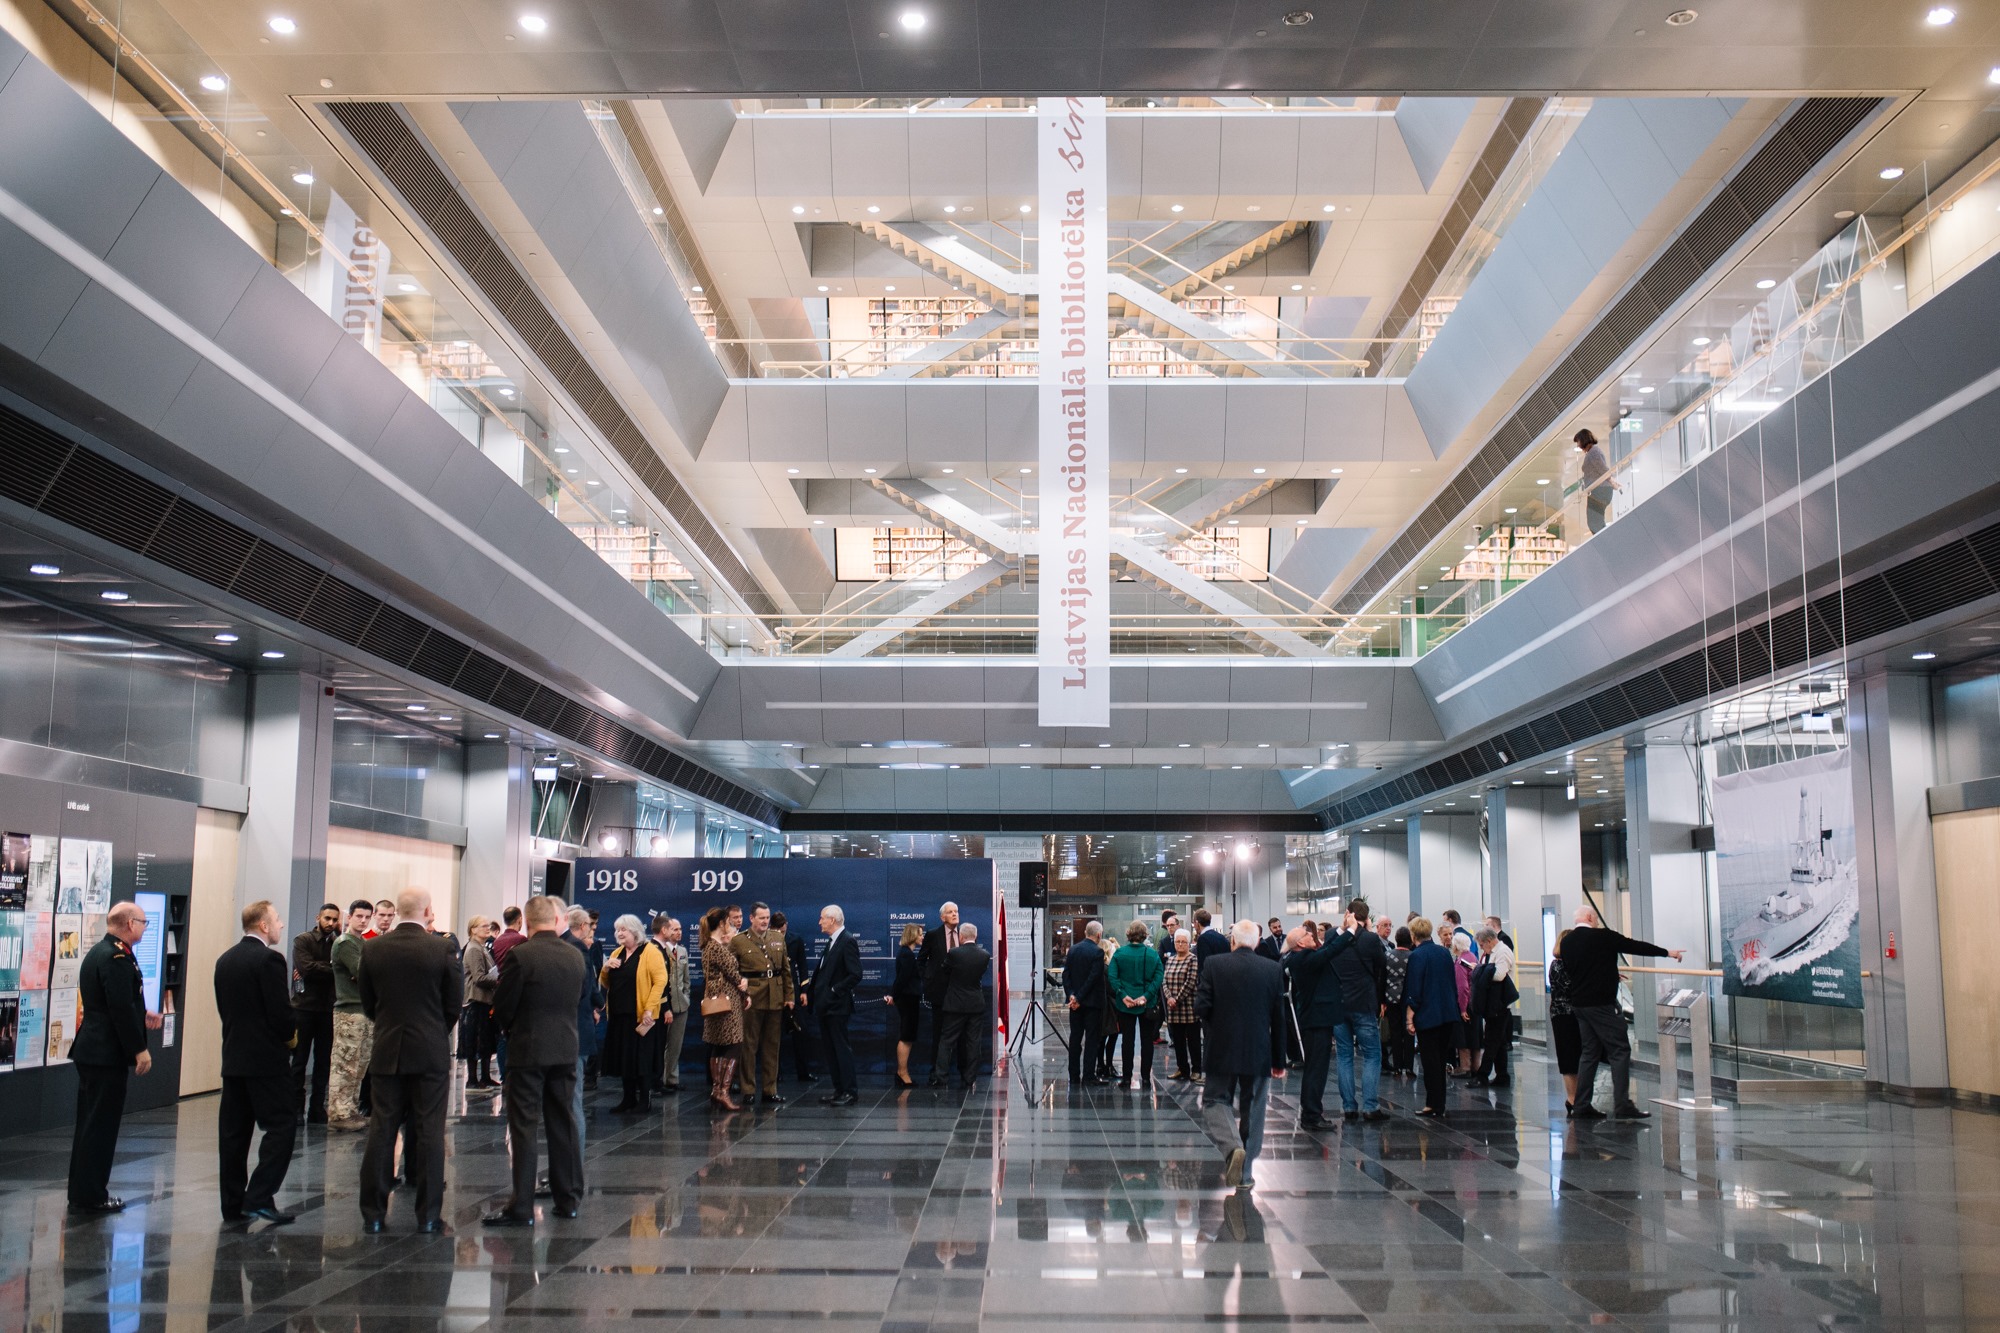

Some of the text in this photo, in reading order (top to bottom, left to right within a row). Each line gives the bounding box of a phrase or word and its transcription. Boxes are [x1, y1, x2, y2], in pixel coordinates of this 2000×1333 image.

[1060, 187, 1086, 360] bibliotēka
[1060, 366, 1087, 539] Nacionālā
[1060, 547, 1093, 690] Latvijas
[586, 869, 639, 892] 1918
[691, 869, 744, 892] 1919
[20, 998, 27, 1007] AT
[20, 1009, 35, 1018] RASTS
